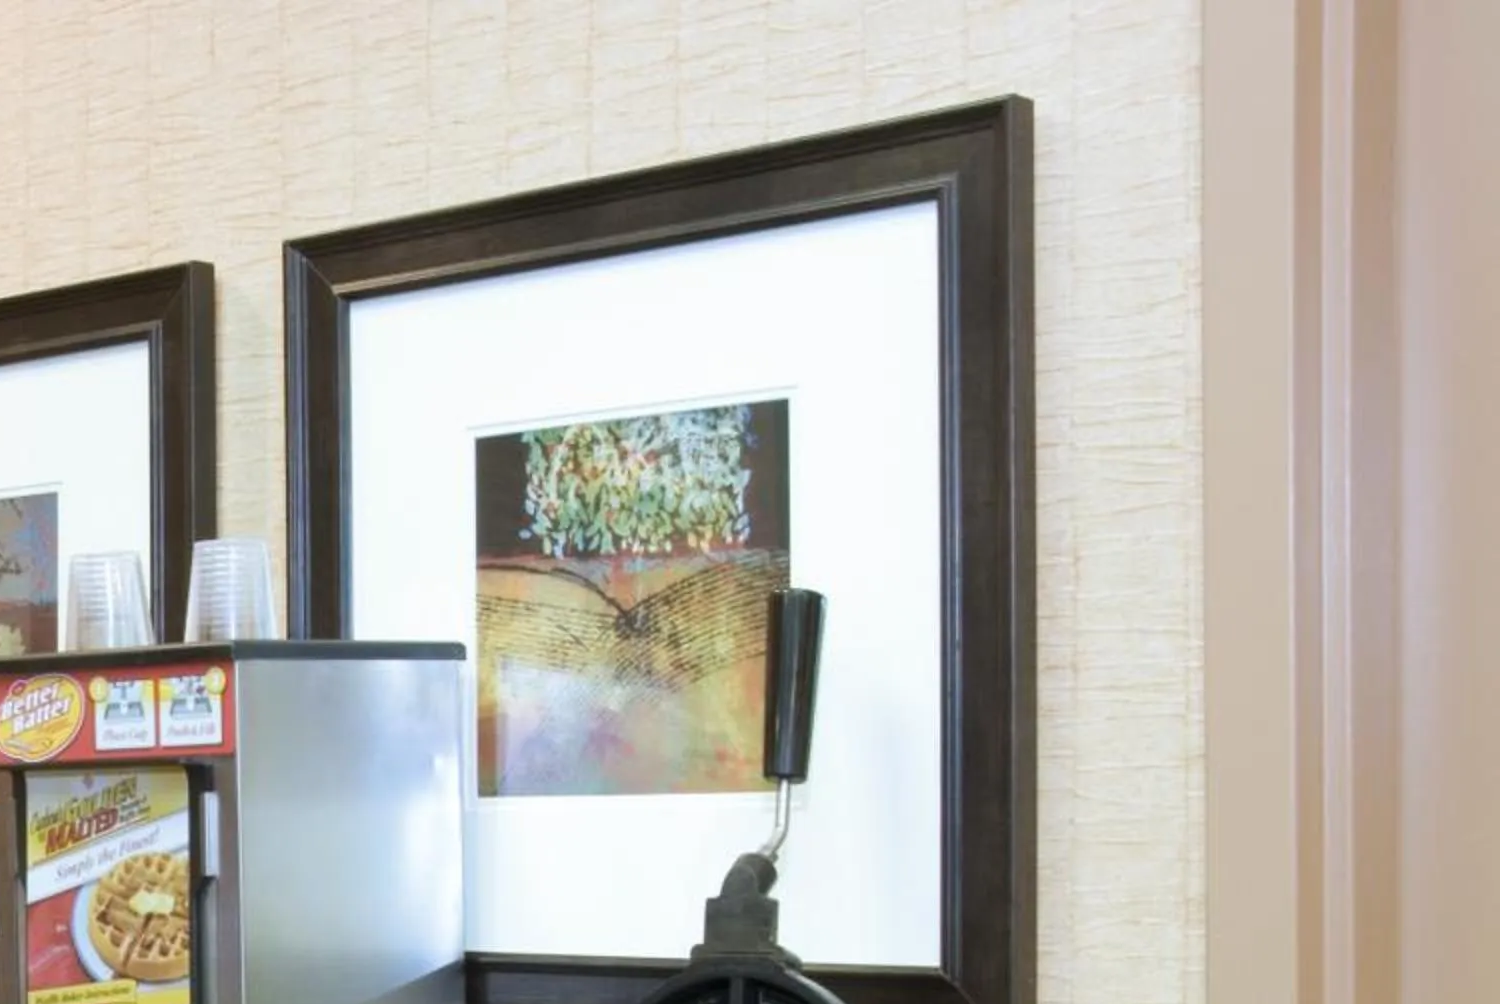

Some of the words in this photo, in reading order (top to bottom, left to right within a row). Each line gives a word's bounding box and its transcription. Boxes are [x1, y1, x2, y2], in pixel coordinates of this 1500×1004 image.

[0, 682, 60, 722] Better
[12, 696, 70, 735] Batter
[45, 807, 120, 856] MALTED
